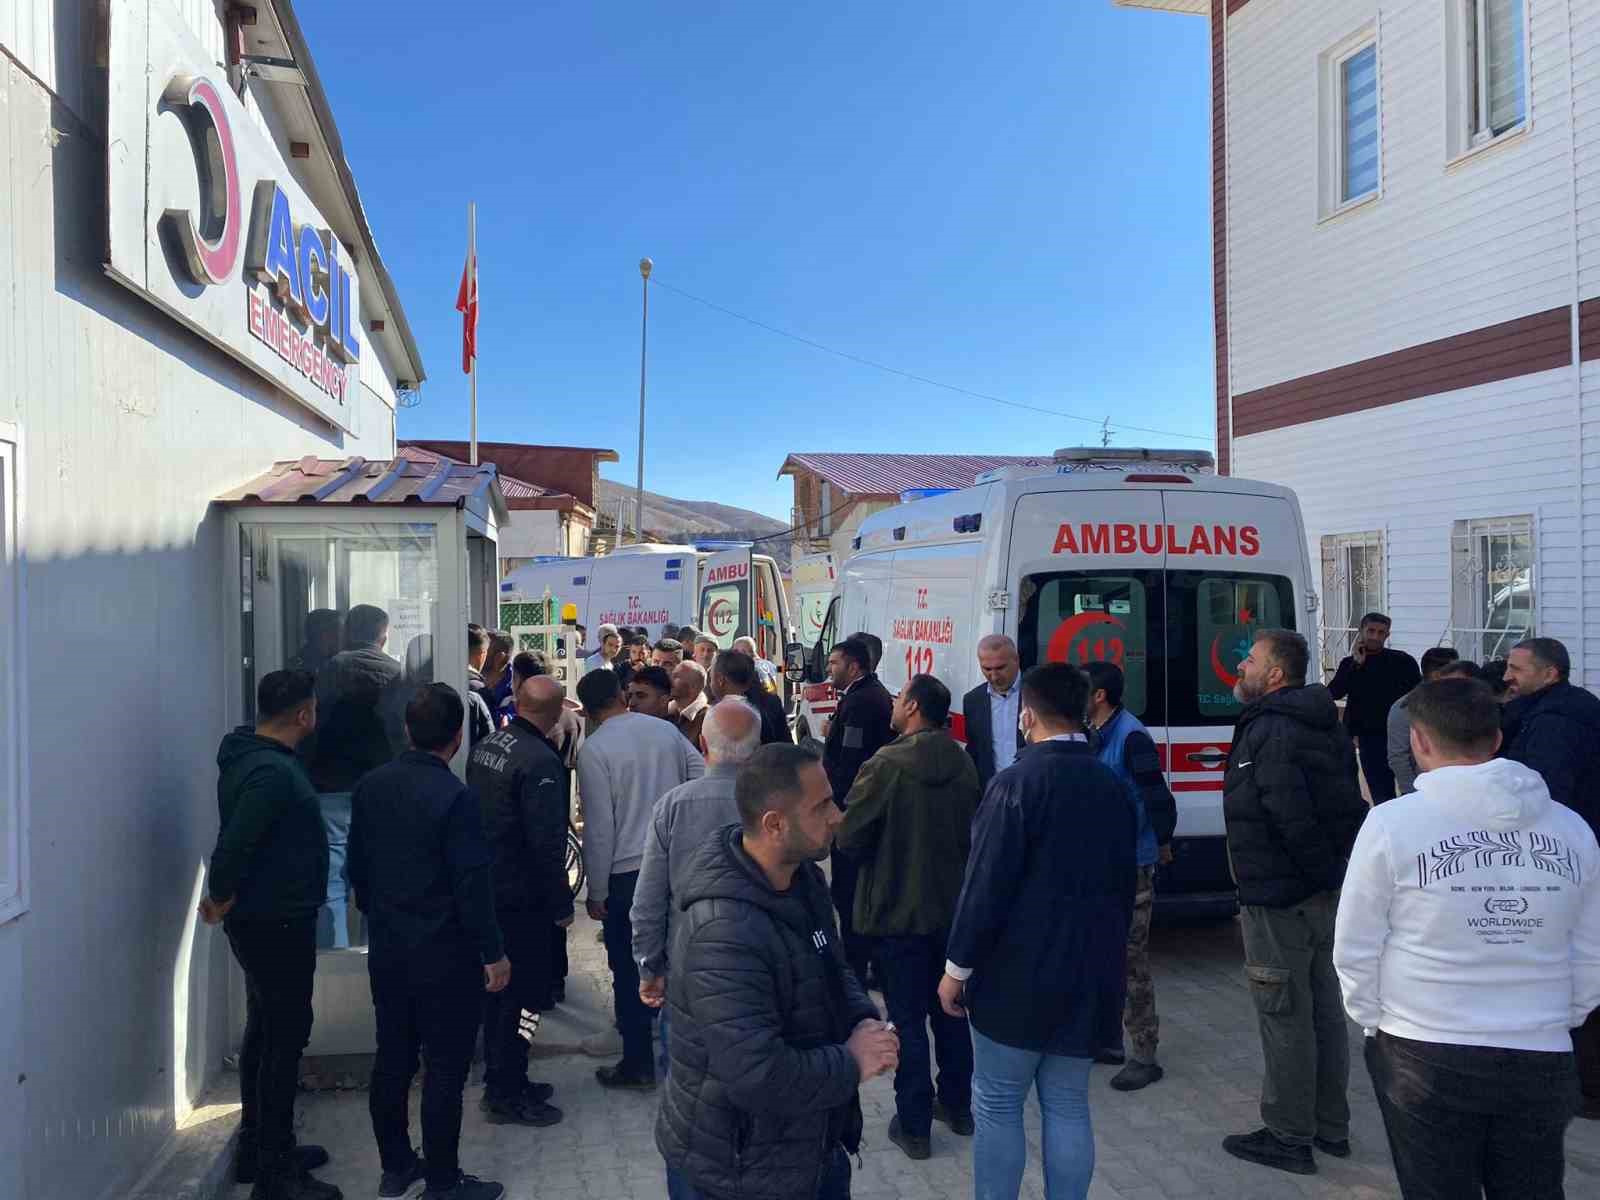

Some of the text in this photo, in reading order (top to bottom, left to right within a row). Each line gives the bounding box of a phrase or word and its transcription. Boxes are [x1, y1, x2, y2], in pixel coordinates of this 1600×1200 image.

[265, 182, 360, 364] ACİL
[249, 290, 348, 403] EMERGENCY
[1052, 523, 1260, 556] AMBULANS
[707, 563, 748, 583] AMBU
[713, 610, 733, 625] 112
[905, 646, 933, 681] 112
[1467, 917, 1544, 928] WORLDWIDE
